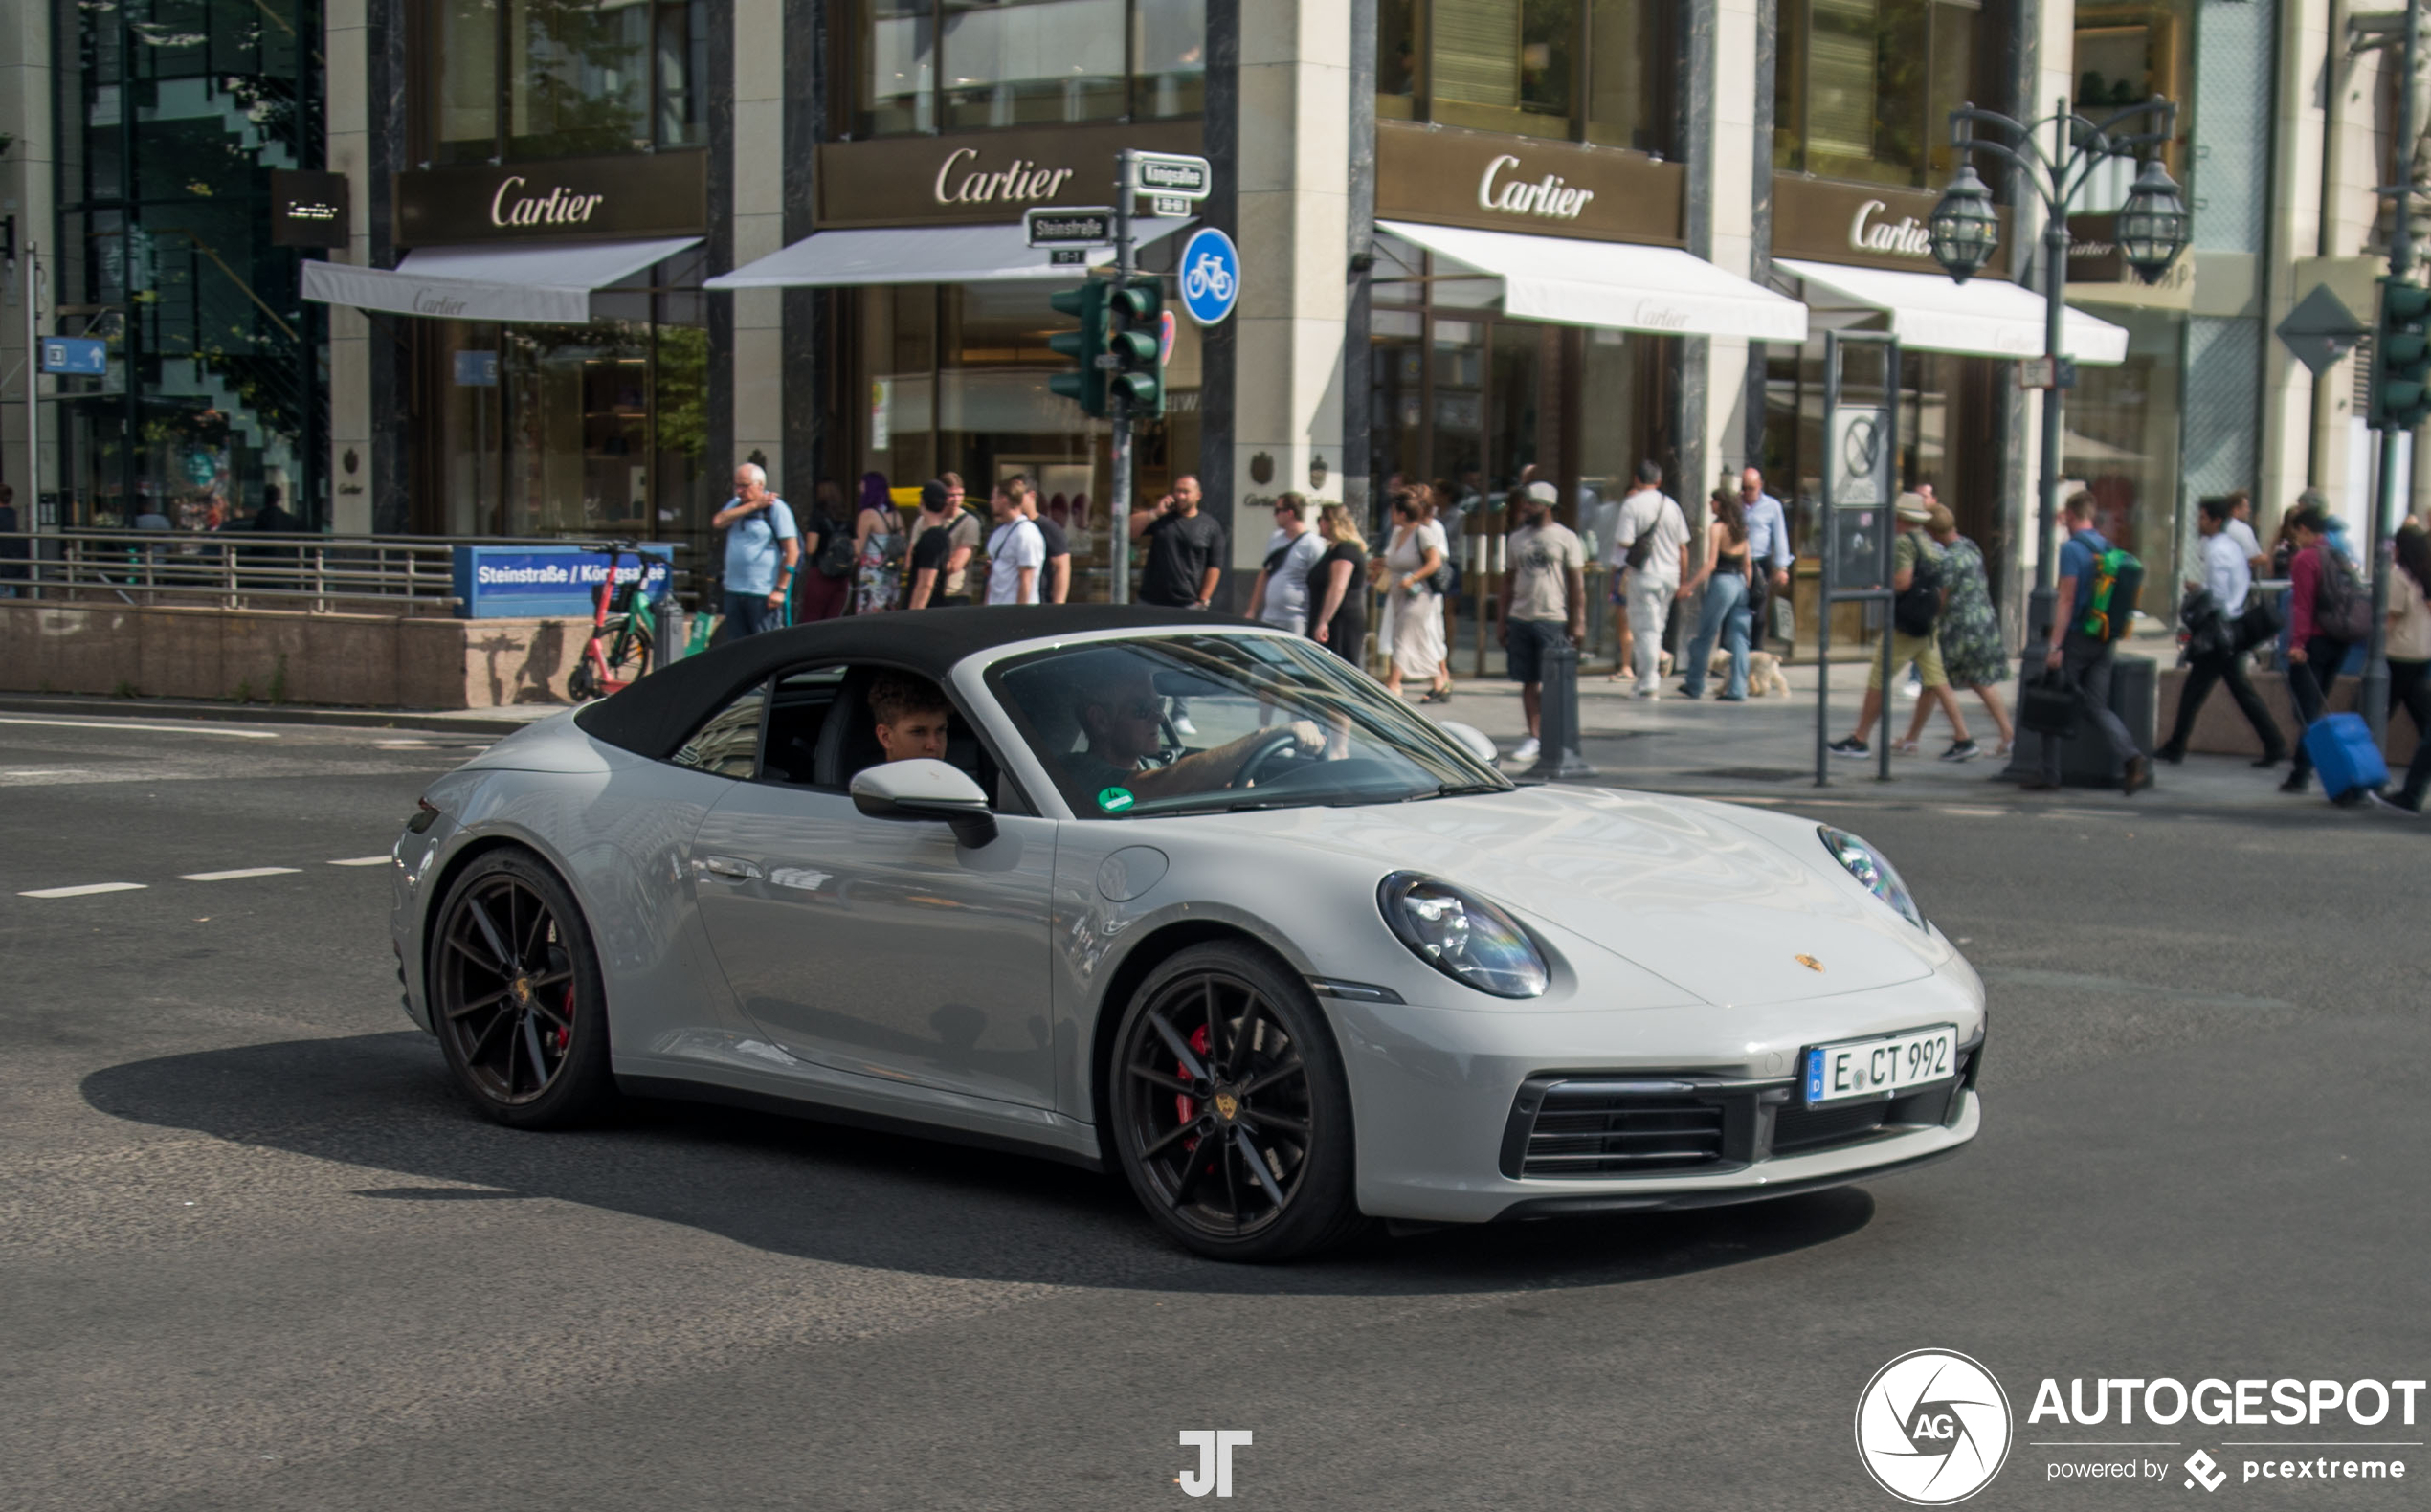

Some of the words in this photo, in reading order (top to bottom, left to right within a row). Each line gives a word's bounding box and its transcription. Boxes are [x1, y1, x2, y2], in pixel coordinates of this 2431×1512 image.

[932, 147, 1073, 203] Cartier
[1145, 164, 1200, 186] Königsallee
[1479, 154, 1595, 217] Cartier
[491, 176, 603, 226] Cartier
[1036, 218, 1102, 236] Steinstraße
[413, 287, 467, 315] Cartier
[1634, 297, 1691, 327] Cartier
[479, 565, 568, 583] Steinstraße
[1834, 1053, 1852, 1092] E
[1870, 1045, 1903, 1086] CT
[1908, 1036, 1948, 1079] 992
[1813, 1079, 1820, 1093] D
